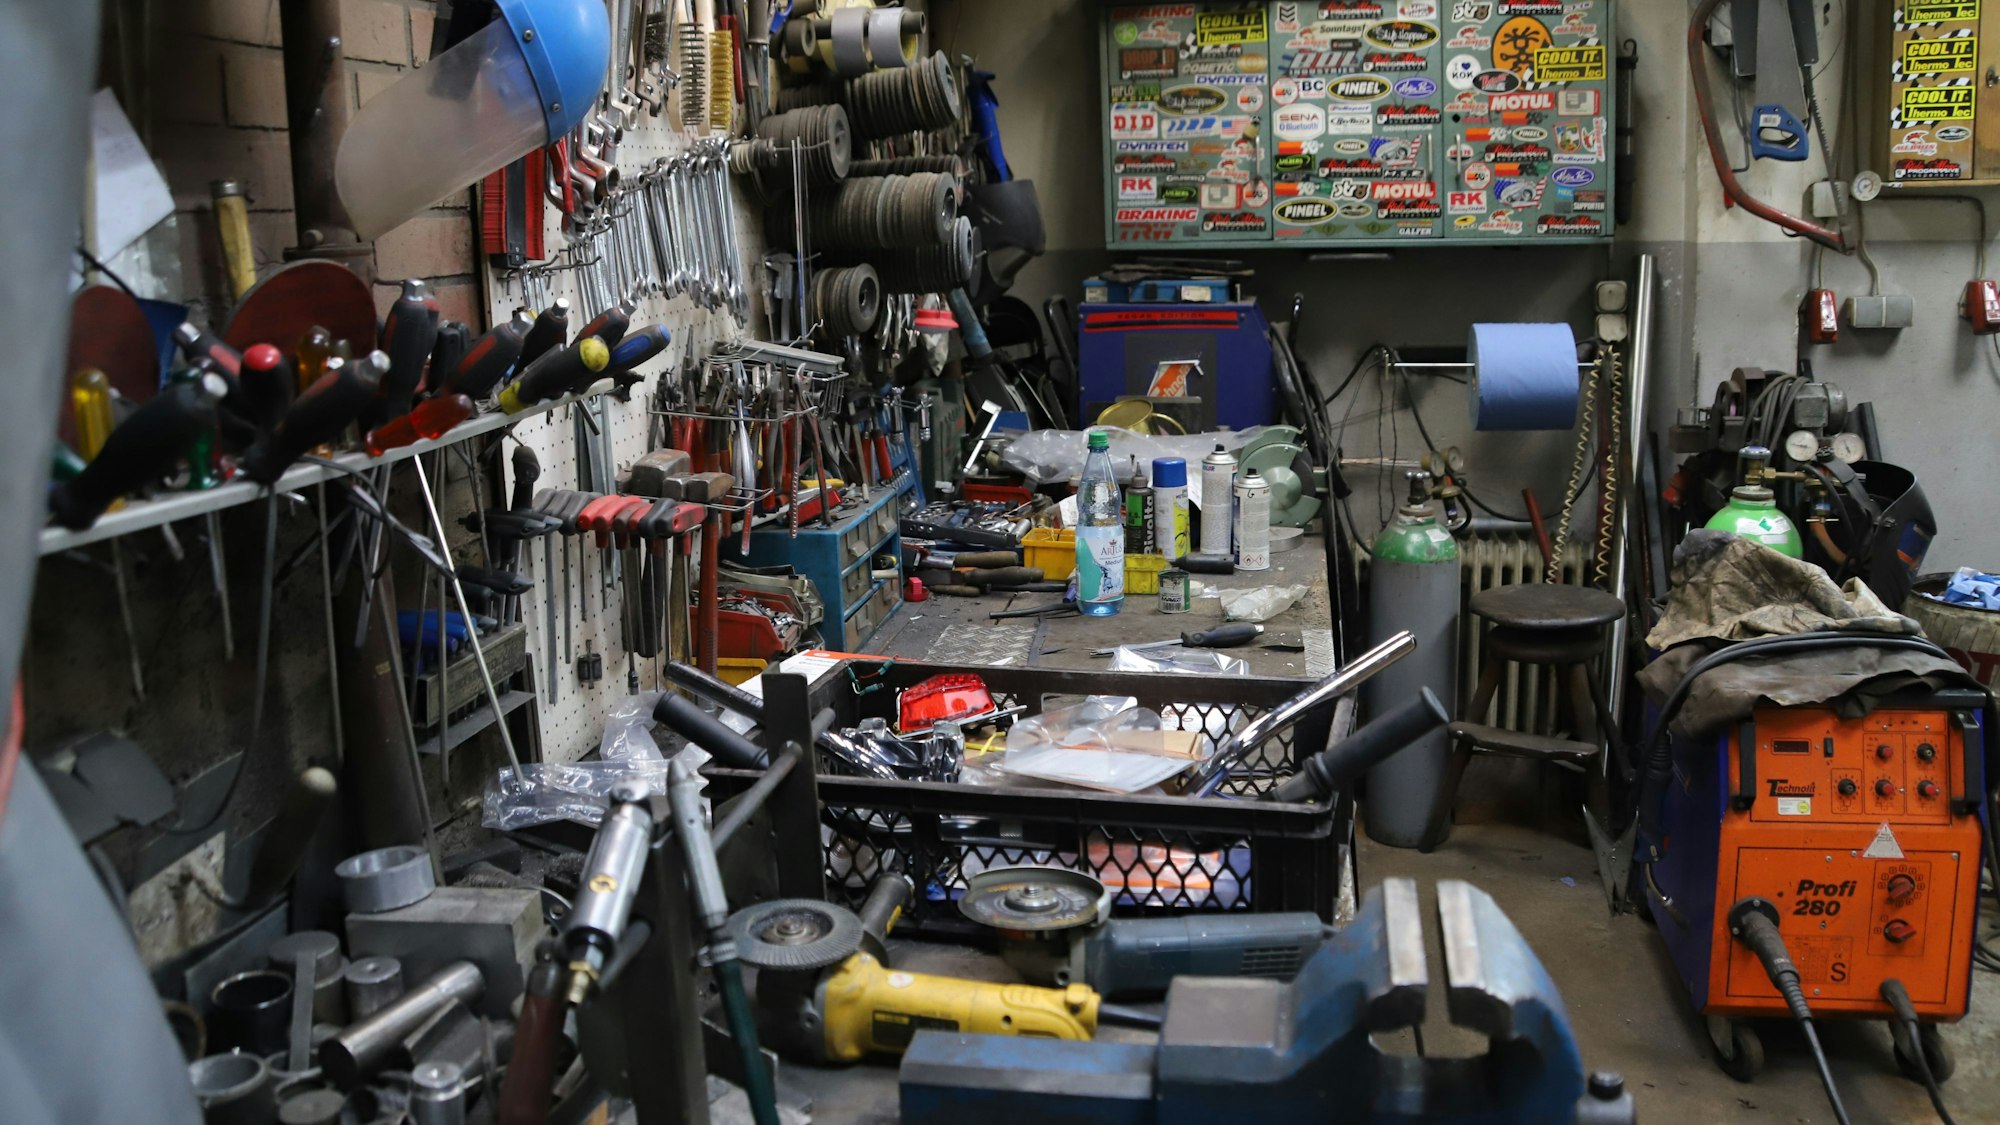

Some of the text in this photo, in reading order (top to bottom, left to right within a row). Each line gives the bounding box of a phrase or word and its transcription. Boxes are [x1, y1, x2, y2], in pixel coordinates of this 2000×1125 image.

[1911, 6, 1974, 20] Thermo Tec
[1201, 14, 1258, 28] COOL IT
[1201, 27, 1263, 42] Thermo Tec
[1908, 42, 1969, 56] COOL IT
[1539, 51, 1597, 64] COOL IT
[1907, 56, 1972, 70] Thermo Tec
[1452, 71, 1474, 79] KOK
[1539, 66, 1601, 78] Thermo Tec
[1196, 75, 1265, 84] DYNATEK
[1337, 82, 1380, 95] PINGEL
[1490, 95, 1552, 111] MOTUL
[1906, 91, 1967, 104] COOL IT
[1279, 113, 1319, 121] SENA
[1906, 104, 1970, 118] Thermo Tec
[1286, 123, 1318, 131] Bluetooth
[1119, 142, 1186, 150] DYNATEK
[1121, 178, 1153, 190] RK
[1373, 184, 1433, 199] MOTUL
[1450, 193, 1483, 205] RK
[1284, 205, 1328, 217] PINGEL
[1573, 202, 1605, 210] SUPPORTER
[1117, 209, 1197, 221] BRAKING
[1766, 779, 1816, 797] Technolit
[1797, 879, 1857, 897] Profi
[1792, 900, 1841, 916] 280
[1830, 961, 1847, 982] S
